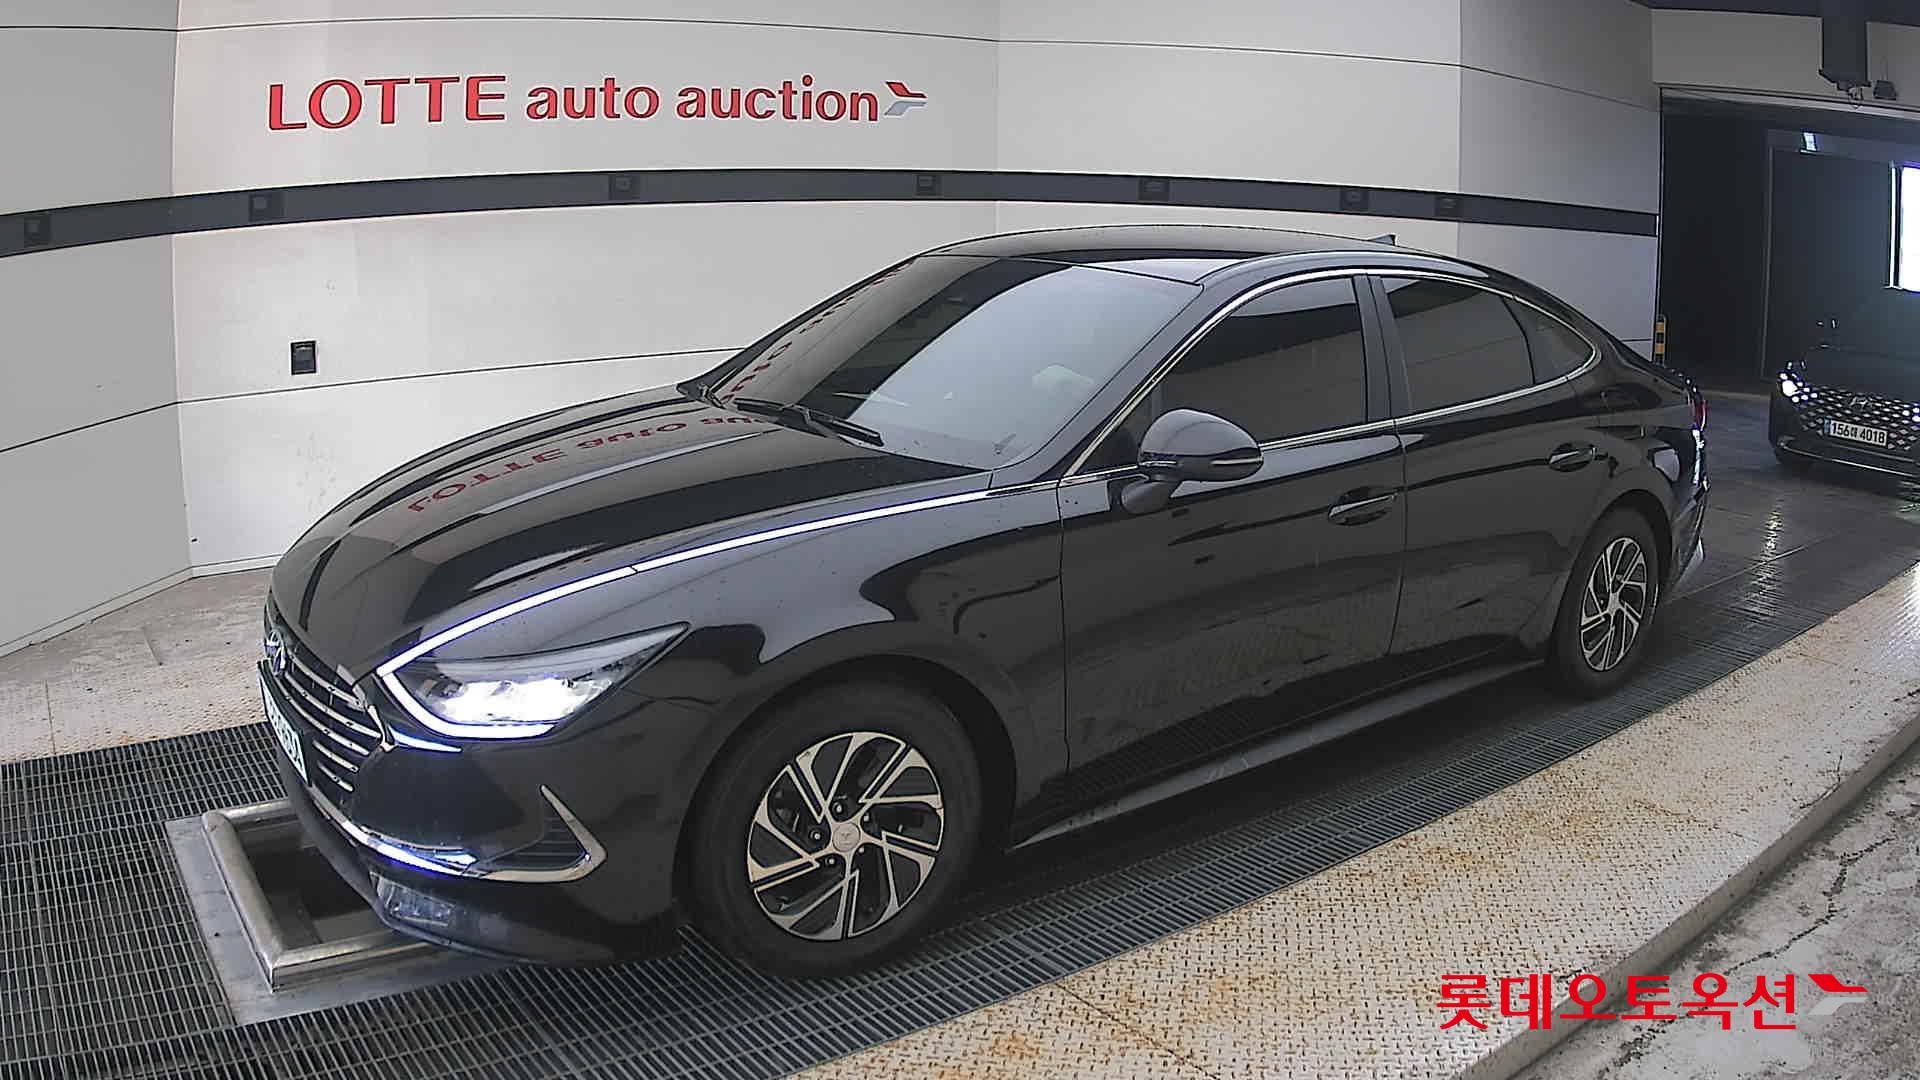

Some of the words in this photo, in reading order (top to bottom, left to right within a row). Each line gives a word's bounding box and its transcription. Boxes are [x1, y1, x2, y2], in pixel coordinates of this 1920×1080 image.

[269, 75, 504, 130] LOTTE
[526, 78, 660, 120] auto
[676, 75, 879, 122] auction
[1860, 428, 1885, 443] 4018
